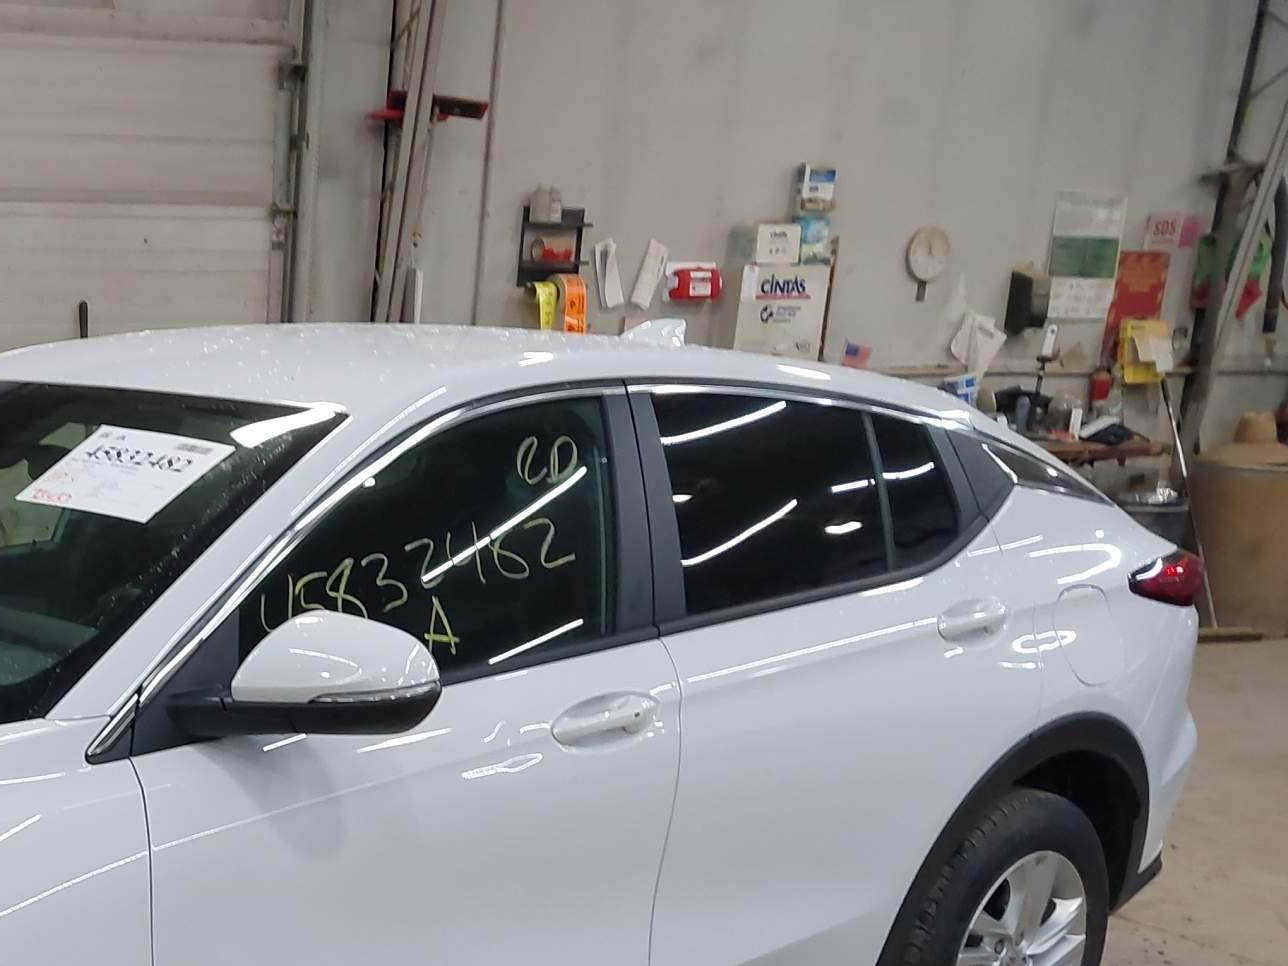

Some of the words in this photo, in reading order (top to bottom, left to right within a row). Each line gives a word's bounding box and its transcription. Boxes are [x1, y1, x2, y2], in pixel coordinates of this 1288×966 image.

[1152, 217, 1176, 236] SDS
[761, 274, 806, 294] CINTAS
[424, 595, 460, 655] A
